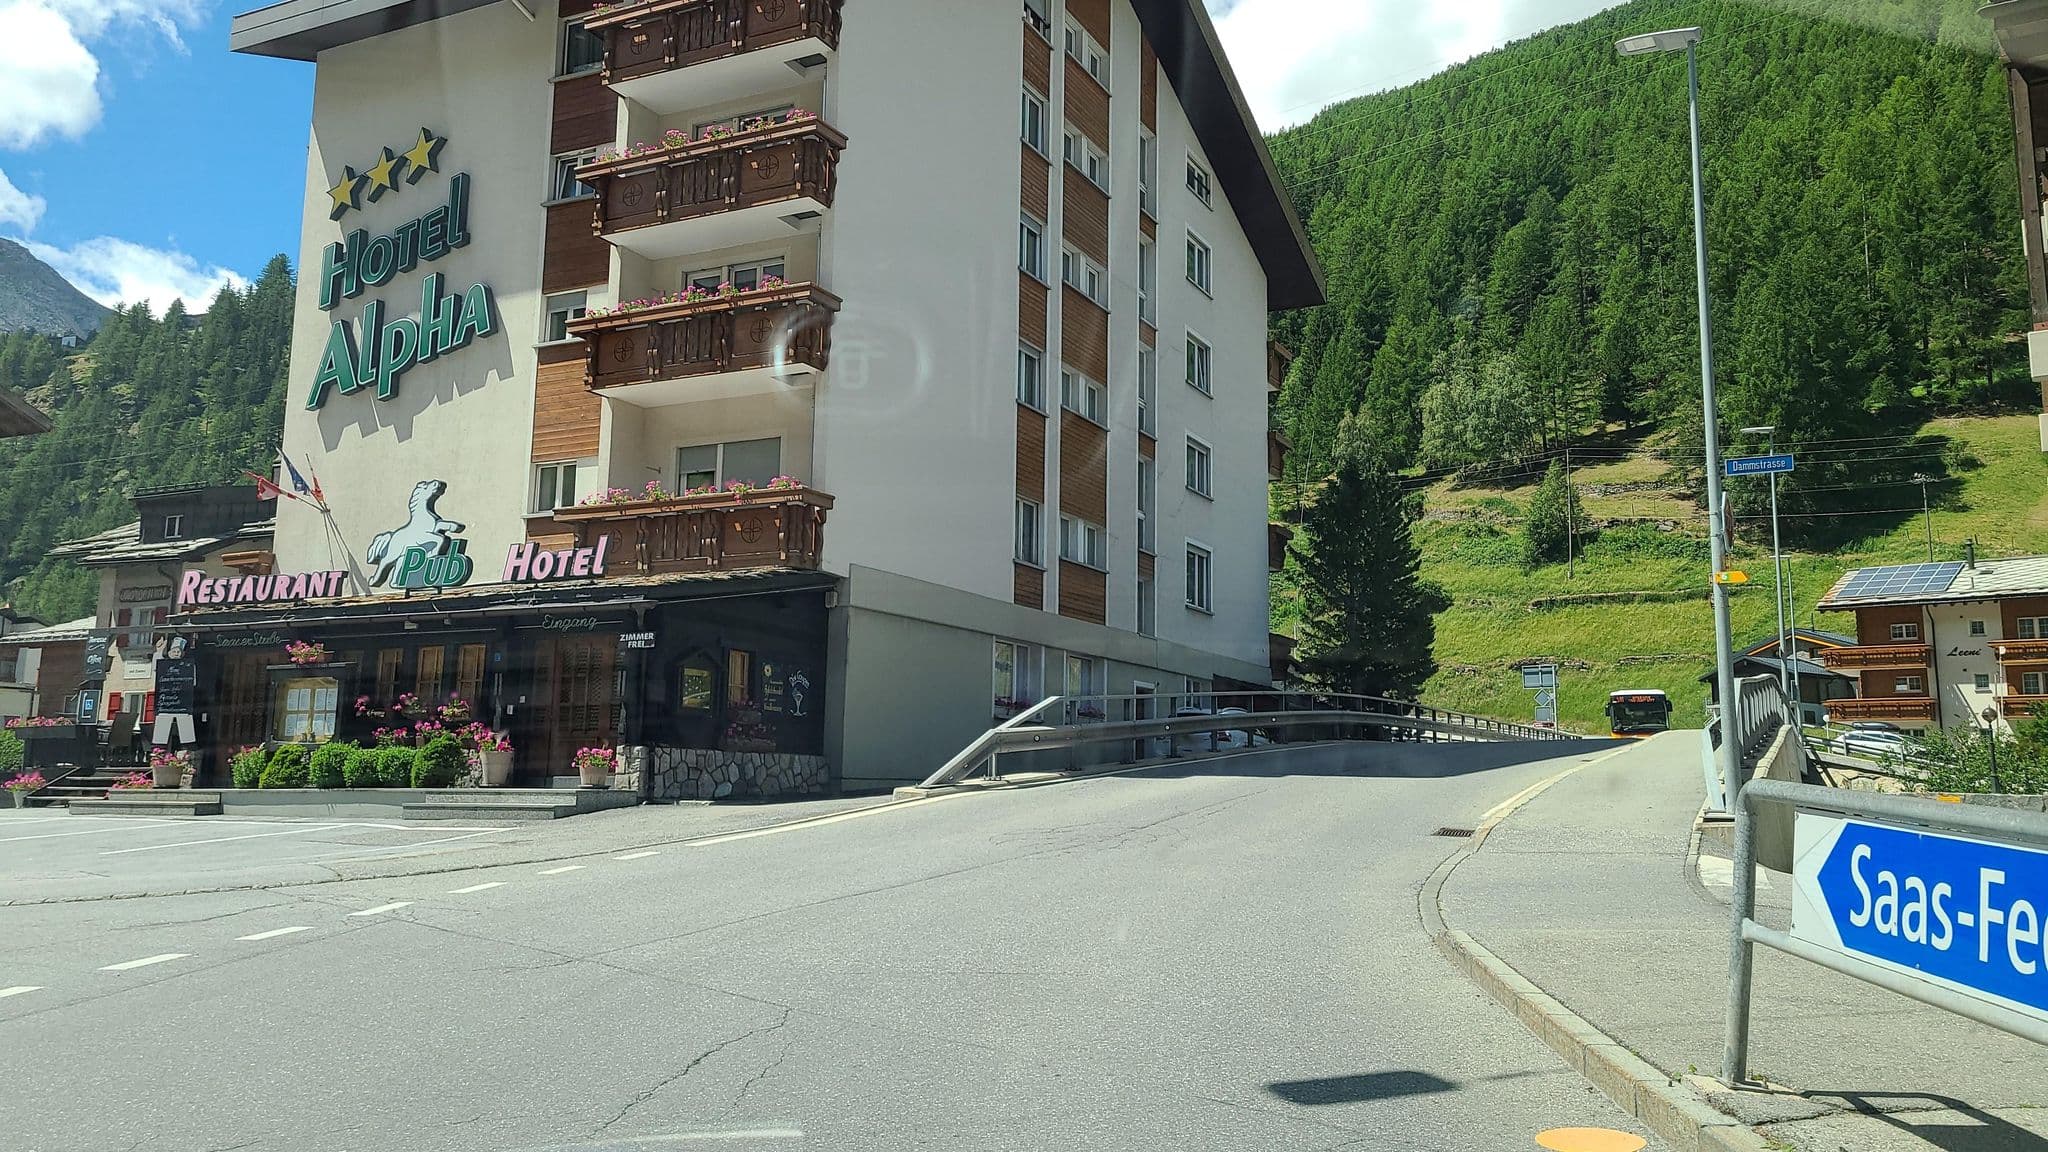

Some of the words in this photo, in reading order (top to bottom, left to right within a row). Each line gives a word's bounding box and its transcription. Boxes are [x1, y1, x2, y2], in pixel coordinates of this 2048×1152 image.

[1732, 460, 1786, 472] Dammstrasse
[178, 571, 347, 604] RESTAURANT
[542, 614, 597, 632] Eingang
[619, 632, 654, 642] ZIMMER
[628, 640, 645, 649] FREI
[1946, 646, 1982, 657] Leeni
[1849, 843, 2048, 976] Saas-Fe
